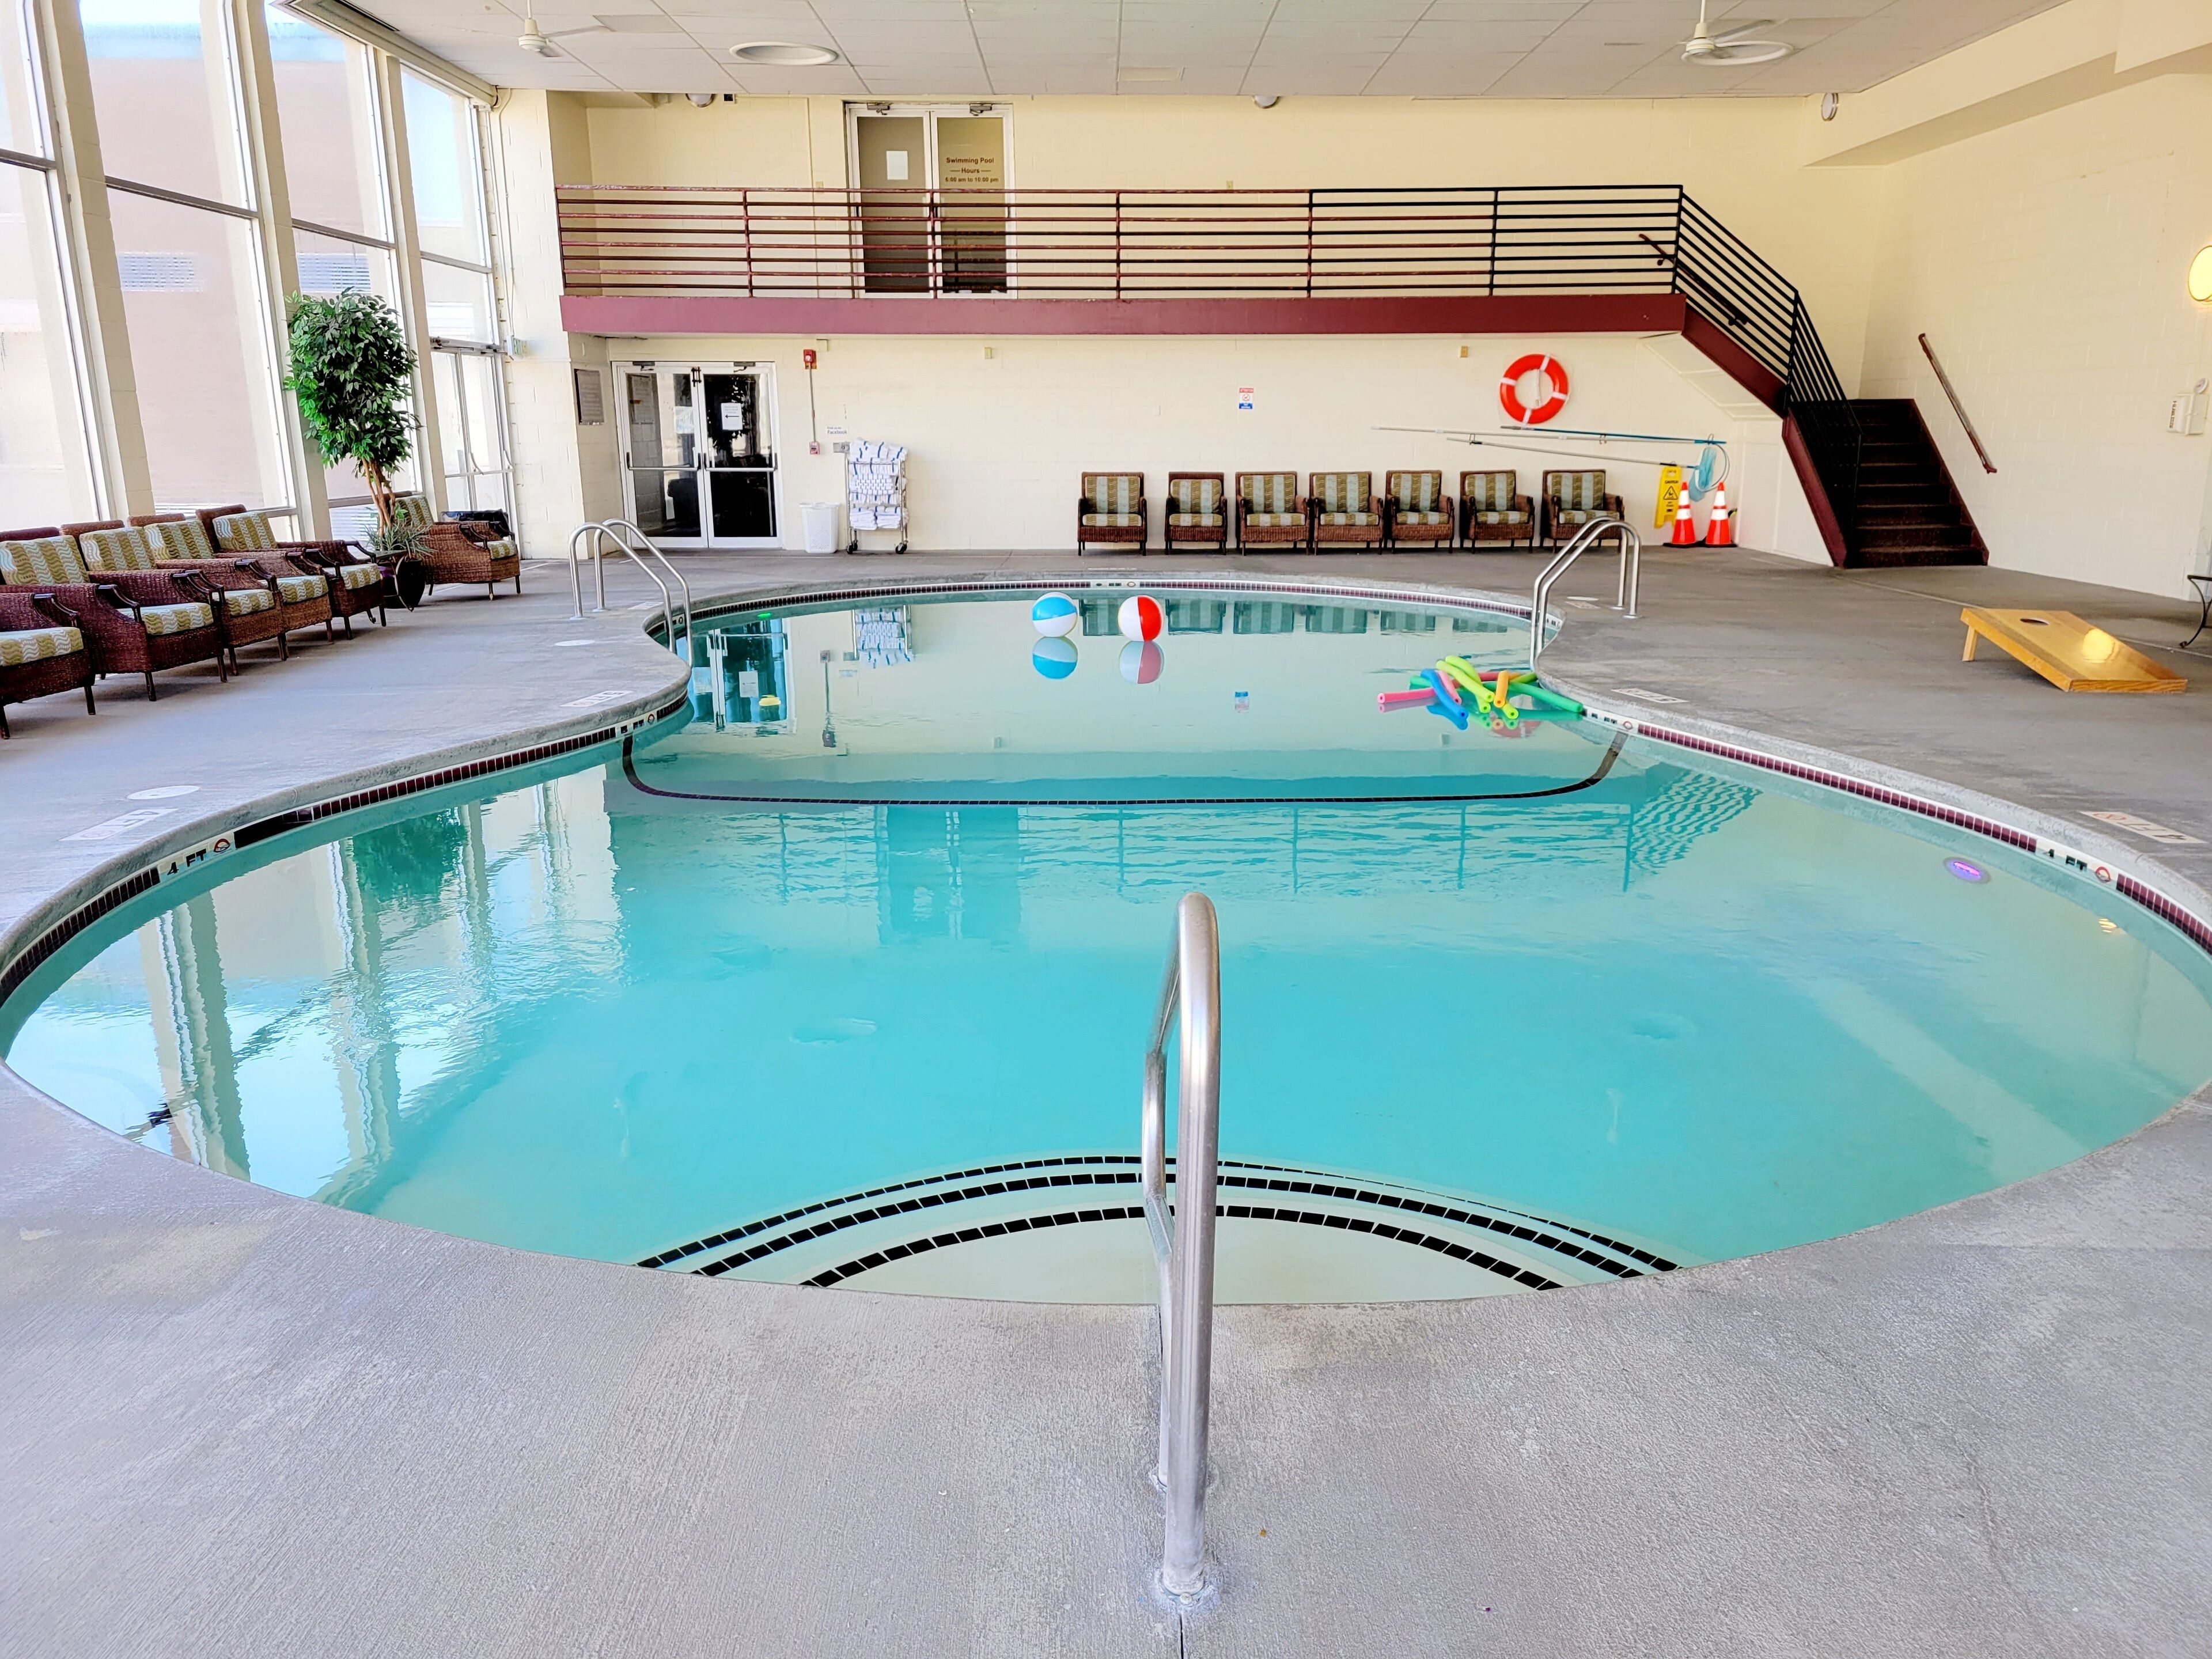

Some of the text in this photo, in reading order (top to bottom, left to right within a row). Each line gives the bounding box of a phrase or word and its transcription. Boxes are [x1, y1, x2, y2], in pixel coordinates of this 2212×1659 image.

[633, 719, 644, 730] FT
[167, 848, 207, 875] 4 FT
[2066, 855, 2088, 870] FT
